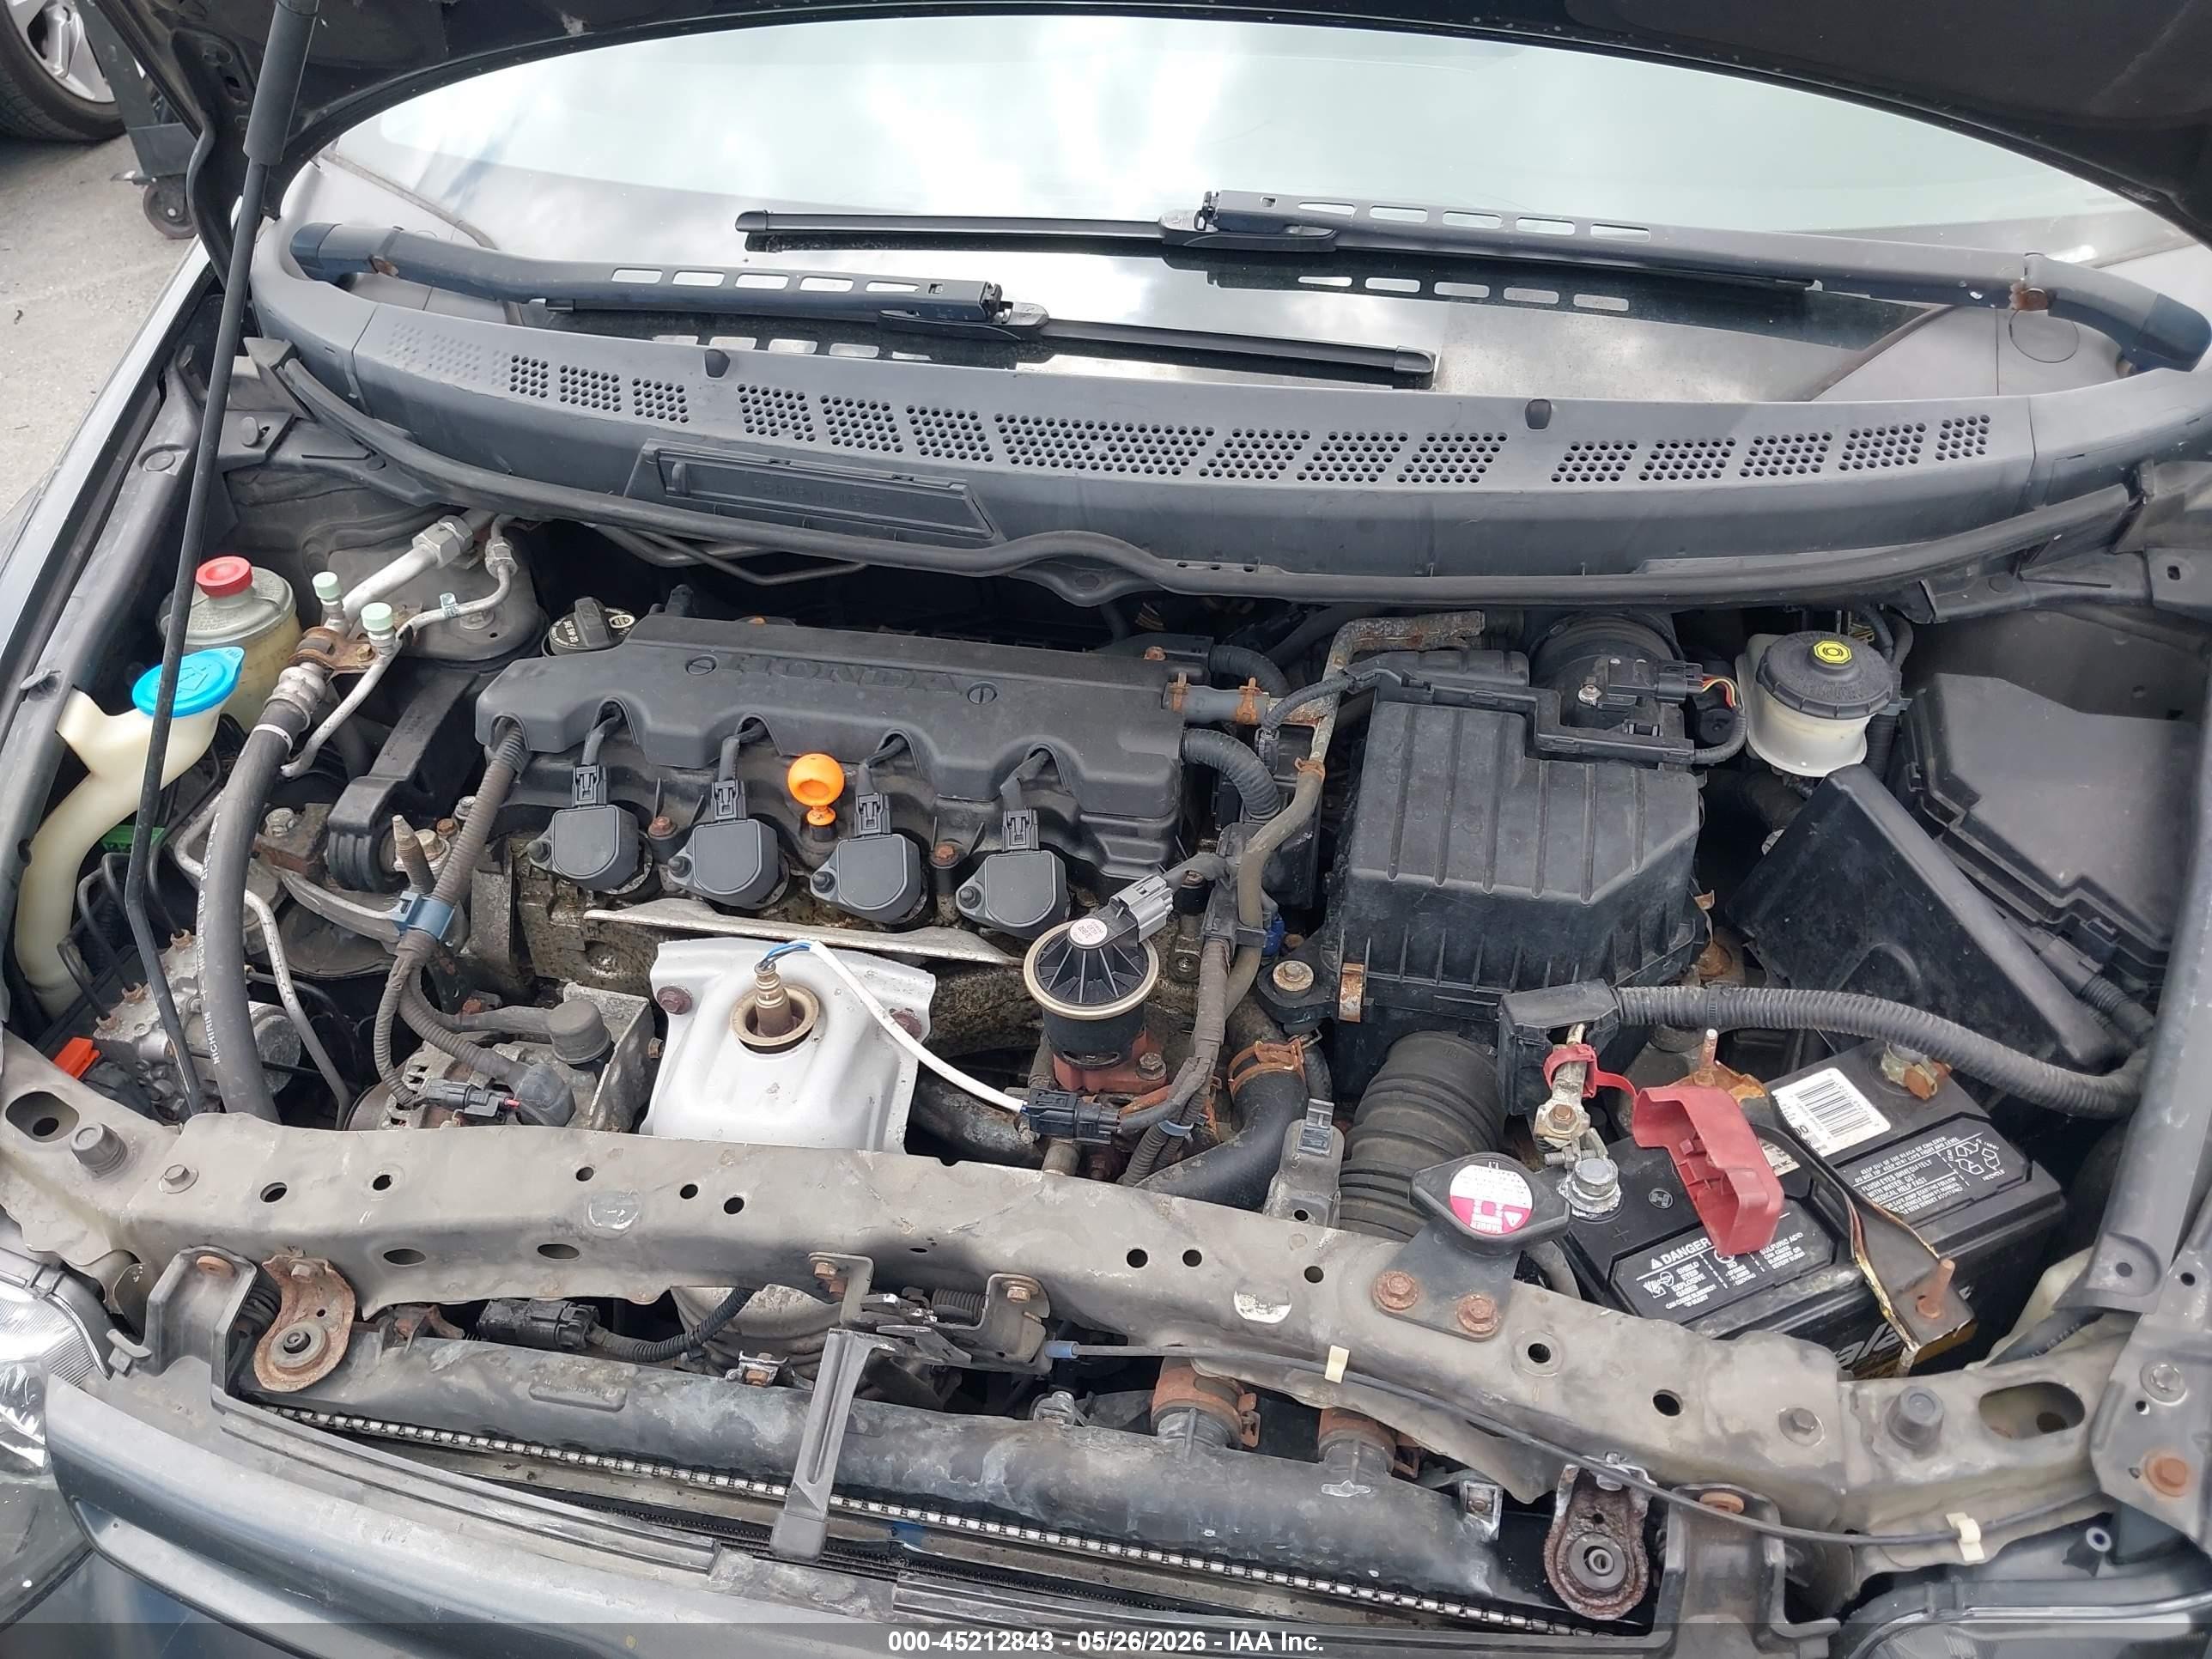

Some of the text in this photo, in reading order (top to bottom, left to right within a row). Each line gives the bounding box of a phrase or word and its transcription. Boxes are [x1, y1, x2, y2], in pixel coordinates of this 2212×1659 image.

[204, 1011, 221, 1065] NICHIRIN
[1661, 1237, 1711, 1264] DANGER
[1759, 1232, 1803, 1255] SULFURIC ACID
[1676, 1261, 1699, 1274] SHIELD
[1681, 1269, 1698, 1280] EYES
[1671, 1274, 1705, 1291] EXPLOSIVE
[1676, 1285, 1698, 1297] GASES
